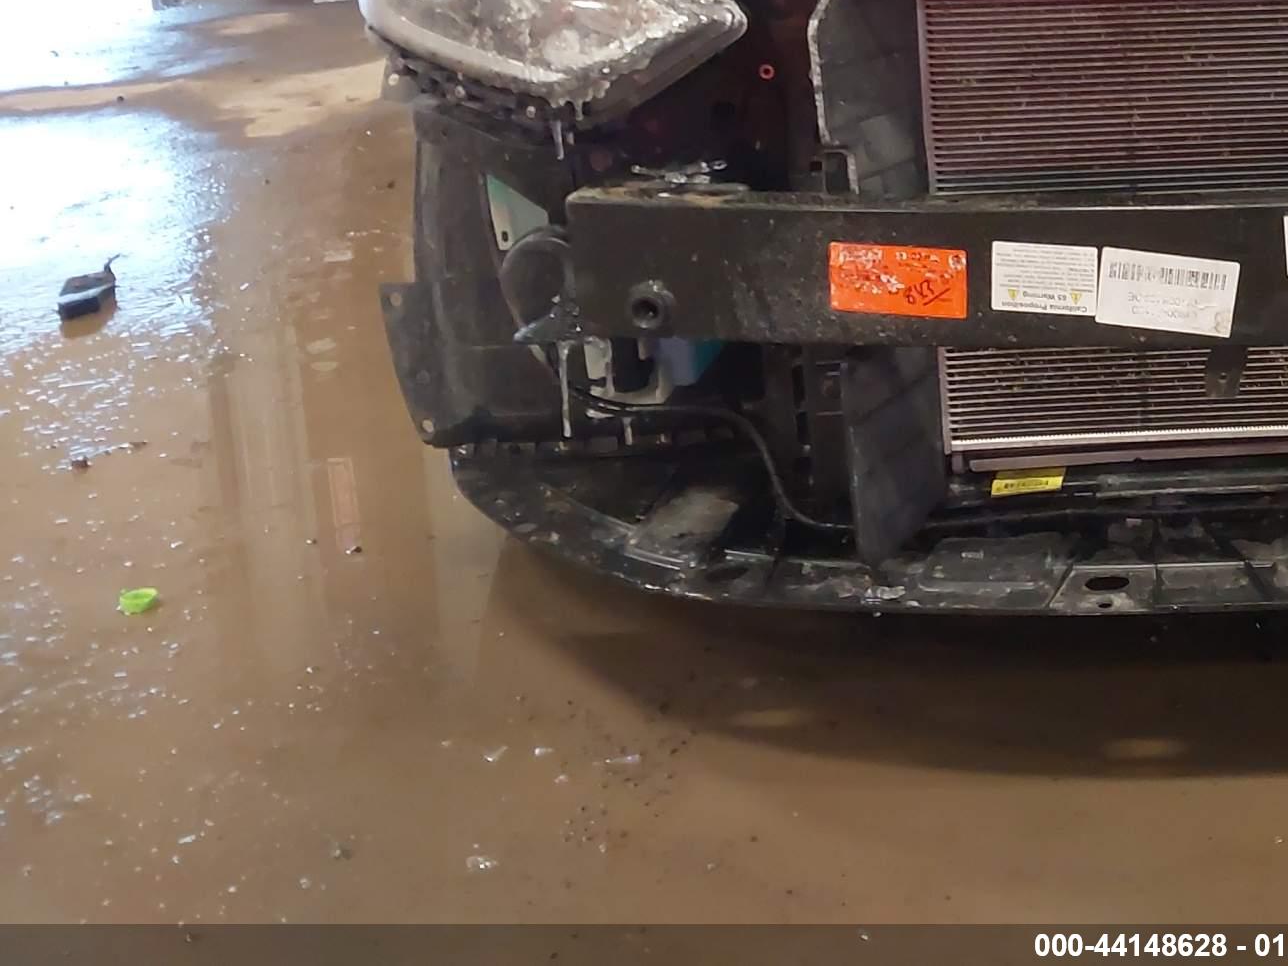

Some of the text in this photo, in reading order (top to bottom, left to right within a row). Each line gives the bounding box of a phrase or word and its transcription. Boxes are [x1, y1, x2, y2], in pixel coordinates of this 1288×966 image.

[1022, 290, 1056, 301] Warning
[1001, 300, 1088, 313] California Proposition
